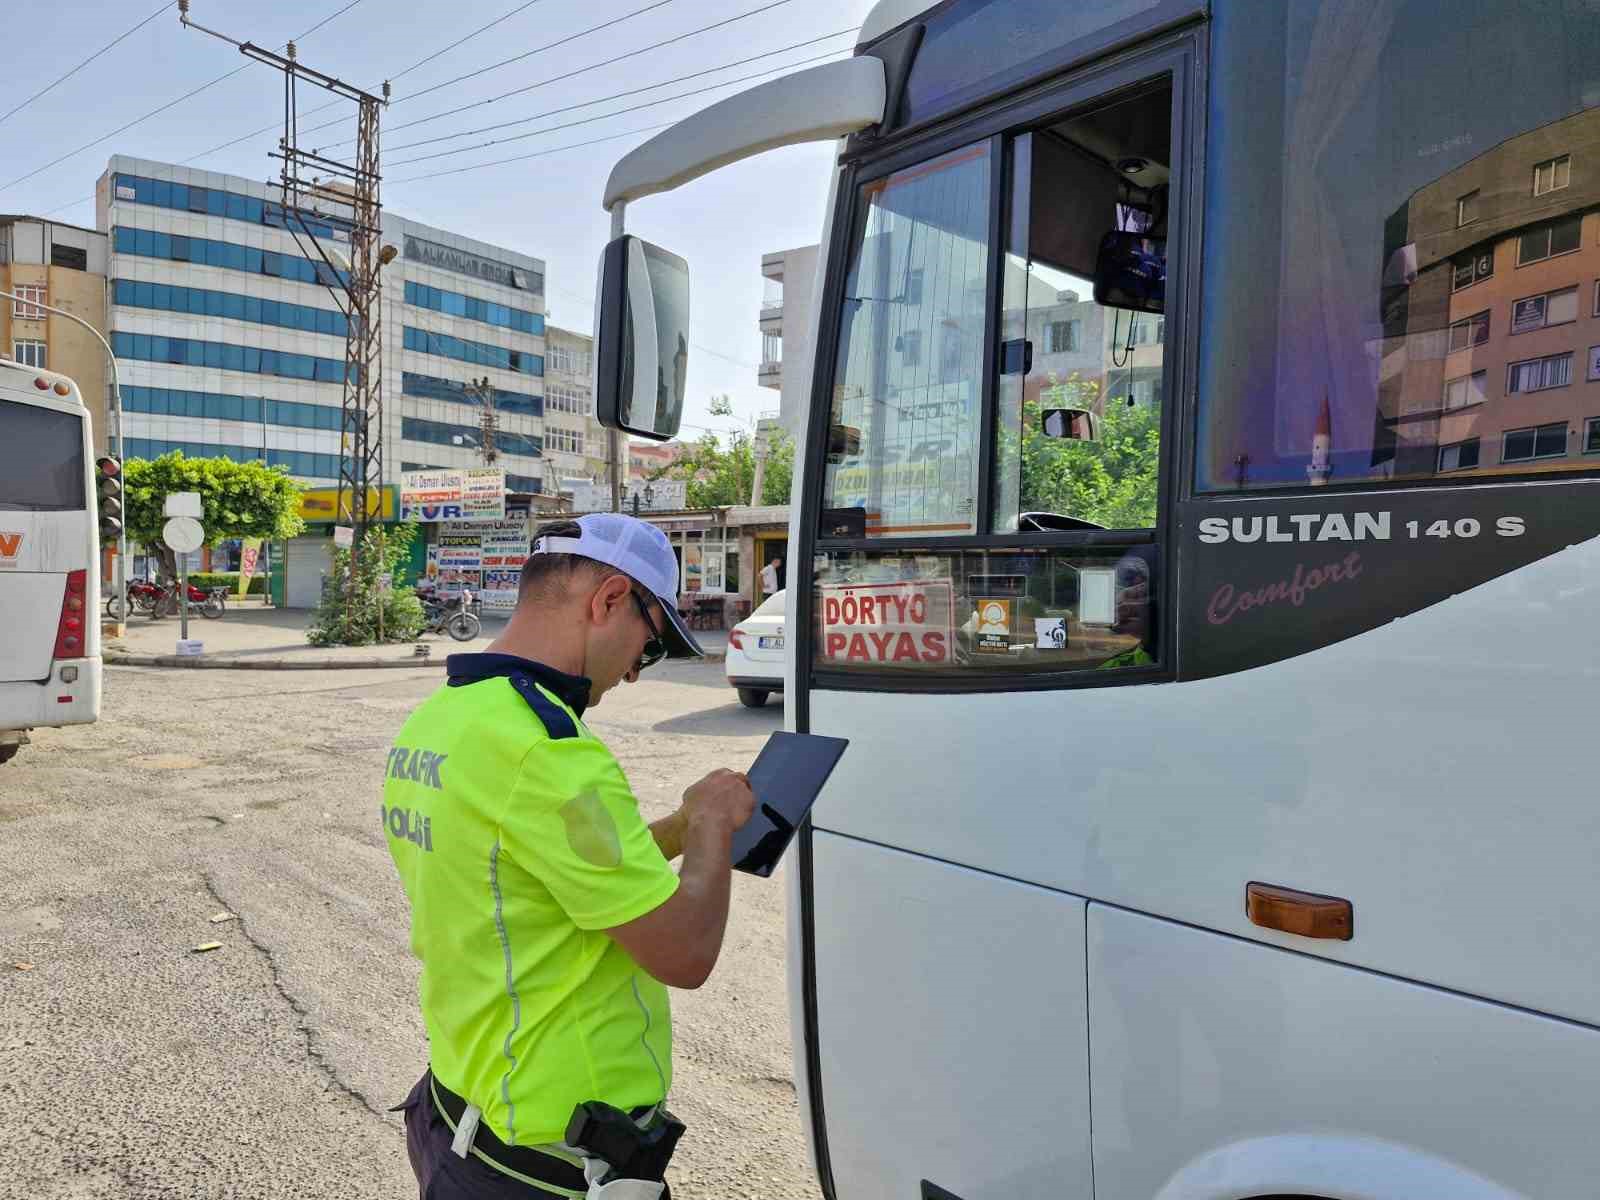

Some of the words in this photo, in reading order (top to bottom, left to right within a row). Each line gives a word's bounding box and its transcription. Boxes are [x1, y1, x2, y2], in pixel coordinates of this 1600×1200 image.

[1199, 512, 1391, 543] SULTAN
[1406, 518, 1481, 538] 140
[1496, 517, 1526, 536] S
[1207, 552, 1362, 624] Comfort
[827, 632, 946, 662] PAYAS
